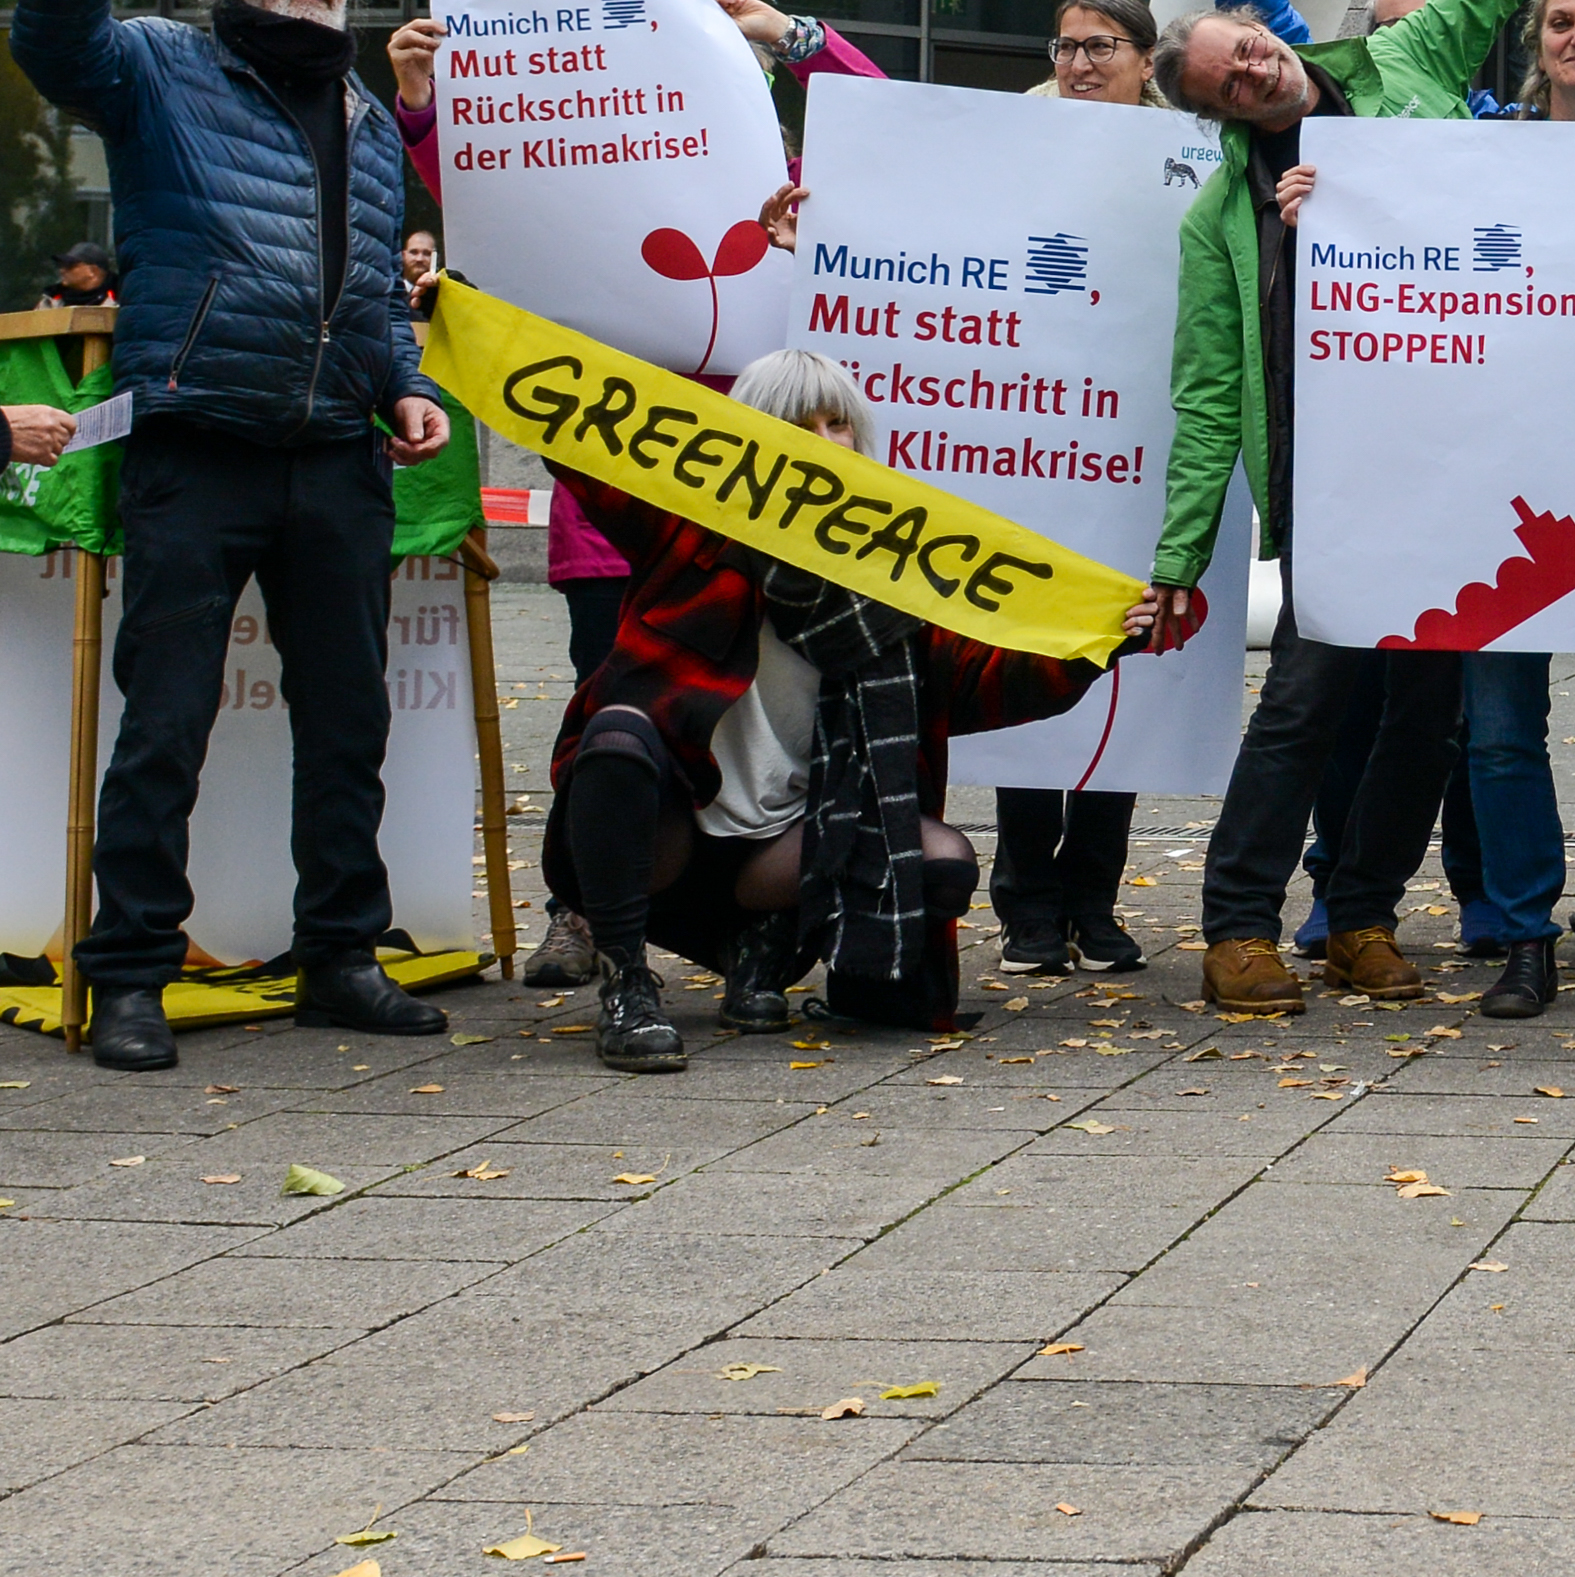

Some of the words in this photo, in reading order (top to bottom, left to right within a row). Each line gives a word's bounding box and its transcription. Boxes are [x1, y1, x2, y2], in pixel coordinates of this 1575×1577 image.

[446, 9, 549, 38] Munich
[556, 8, 593, 32] RE
[450, 48, 518, 79] Mut
[528, 44, 608, 75] statt
[452, 87, 648, 126] Rückschritt
[656, 84, 685, 114] in
[454, 142, 512, 171] der
[523, 128, 710, 169] Klimakrise!
[1181, 145, 1224, 163] urgew
[812, 243, 951, 286] Munich
[961, 256, 1010, 291] RE
[1310, 242, 1415, 271] Munich
[1423, 246, 1460, 272] RE
[808, 293, 901, 338] Mut
[914, 306, 1022, 348] statt
[1309, 330, 1486, 365] STOPPEN!
[840, 360, 1067, 416] ckschritt
[1081, 377, 1119, 420] in
[887, 430, 1145, 485] Klimakrise!
[502, 355, 1054, 613] GREENPEACE
